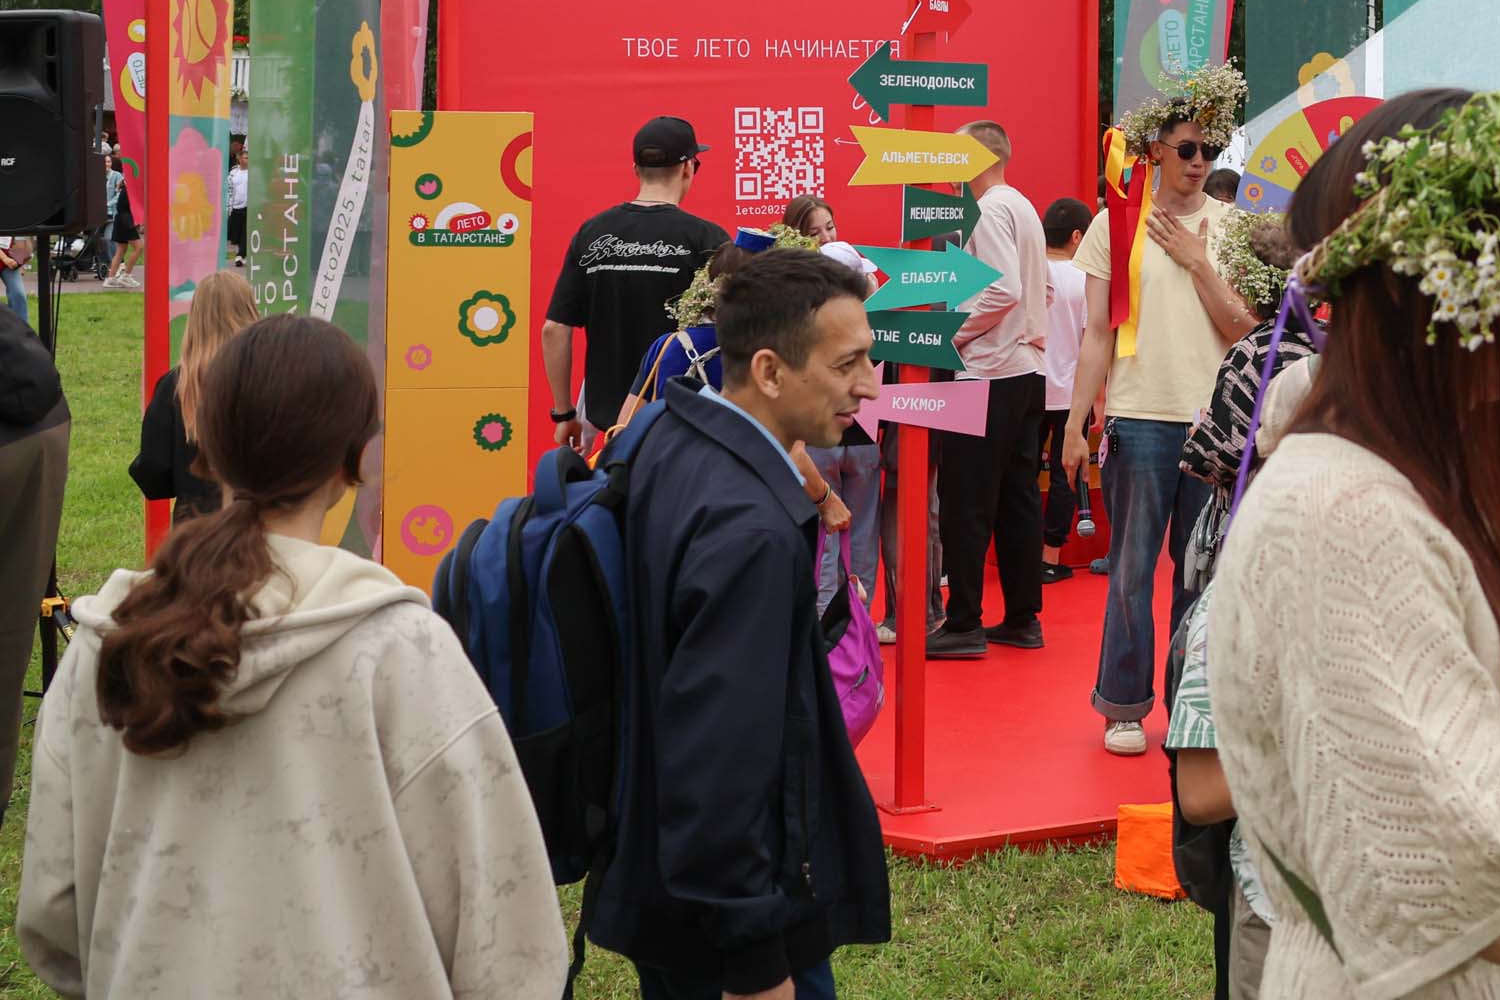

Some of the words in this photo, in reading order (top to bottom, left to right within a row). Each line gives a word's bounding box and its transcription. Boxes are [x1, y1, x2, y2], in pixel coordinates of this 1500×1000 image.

[622, 38, 679, 58] ТВОЕ
[694, 38, 751, 58] ЛЕТО
[879, 73, 975, 90] ЗЕЛЕНОДОЛЬСК
[881, 150, 969, 166] АЛЬМЕТЬЕВСК
[315, 120, 372, 314] leto2025.tatar
[910, 207, 964, 222] МЕНДЕЛЕЕВСК
[456, 215, 485, 230] ЛЕТО
[417, 233, 425, 243] В
[433, 232, 506, 244] ТАТАРСТАНЕ
[901, 271, 957, 284] ЕЛАБУГА
[908, 332, 942, 346] САБЫ
[892, 396, 946, 412] КУКМОР
